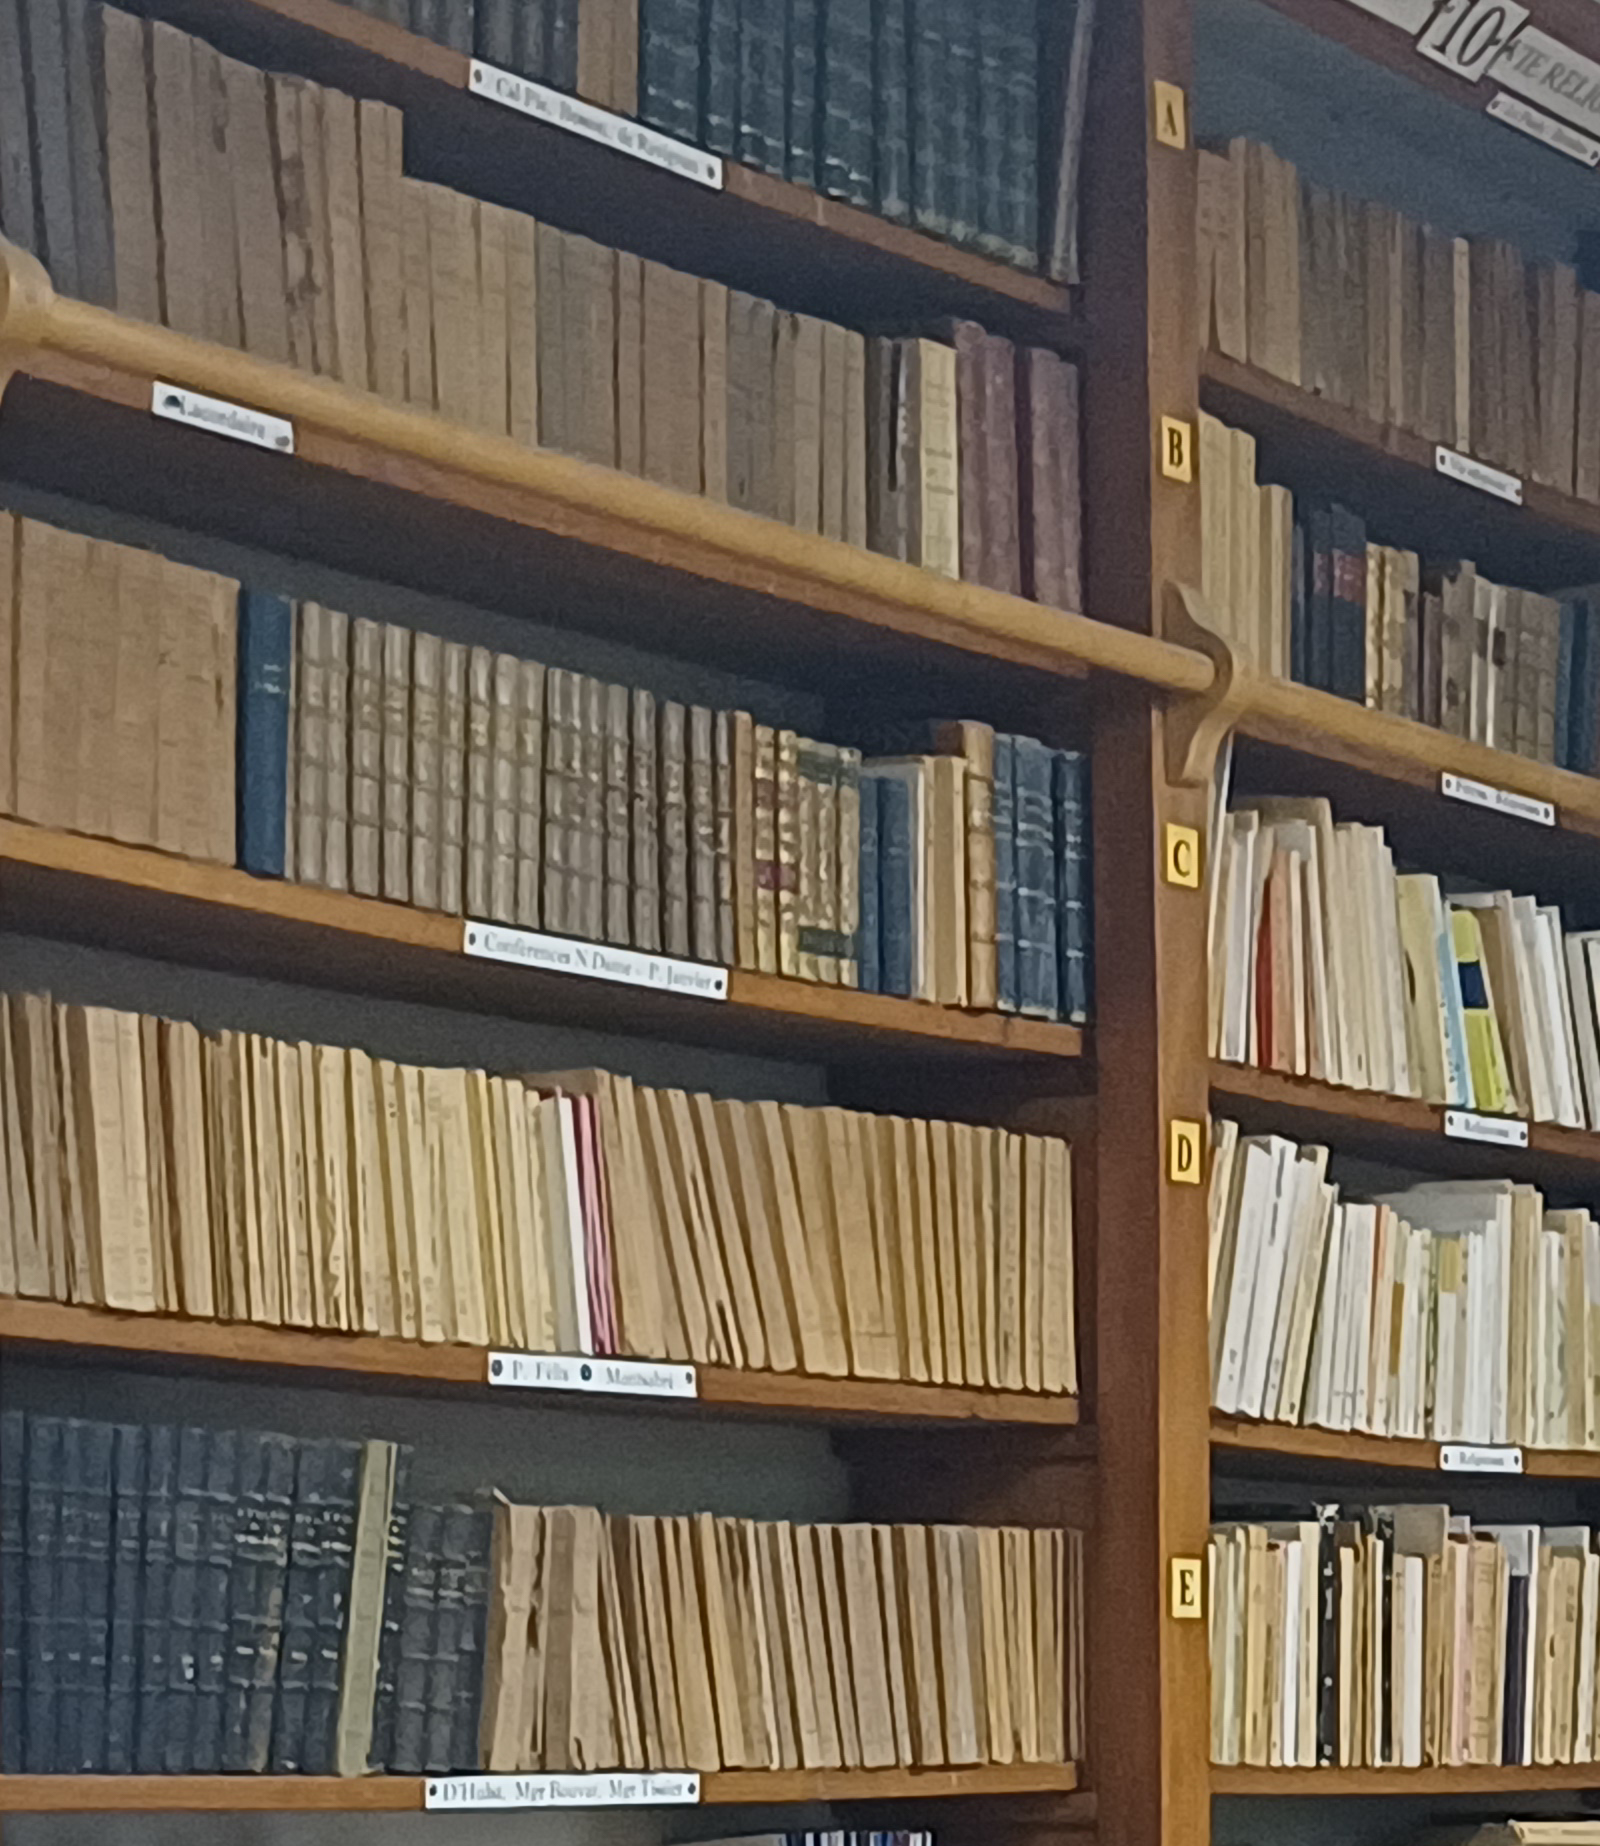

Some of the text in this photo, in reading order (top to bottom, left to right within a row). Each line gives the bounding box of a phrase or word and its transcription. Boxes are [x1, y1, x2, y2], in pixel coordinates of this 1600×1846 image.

[1162, 102, 1178, 137] A
[1168, 428, 1183, 467] B
[1173, 840, 1190, 877] C
[1178, 1134, 1192, 1171] D
[1180, 1570, 1194, 1606] E
